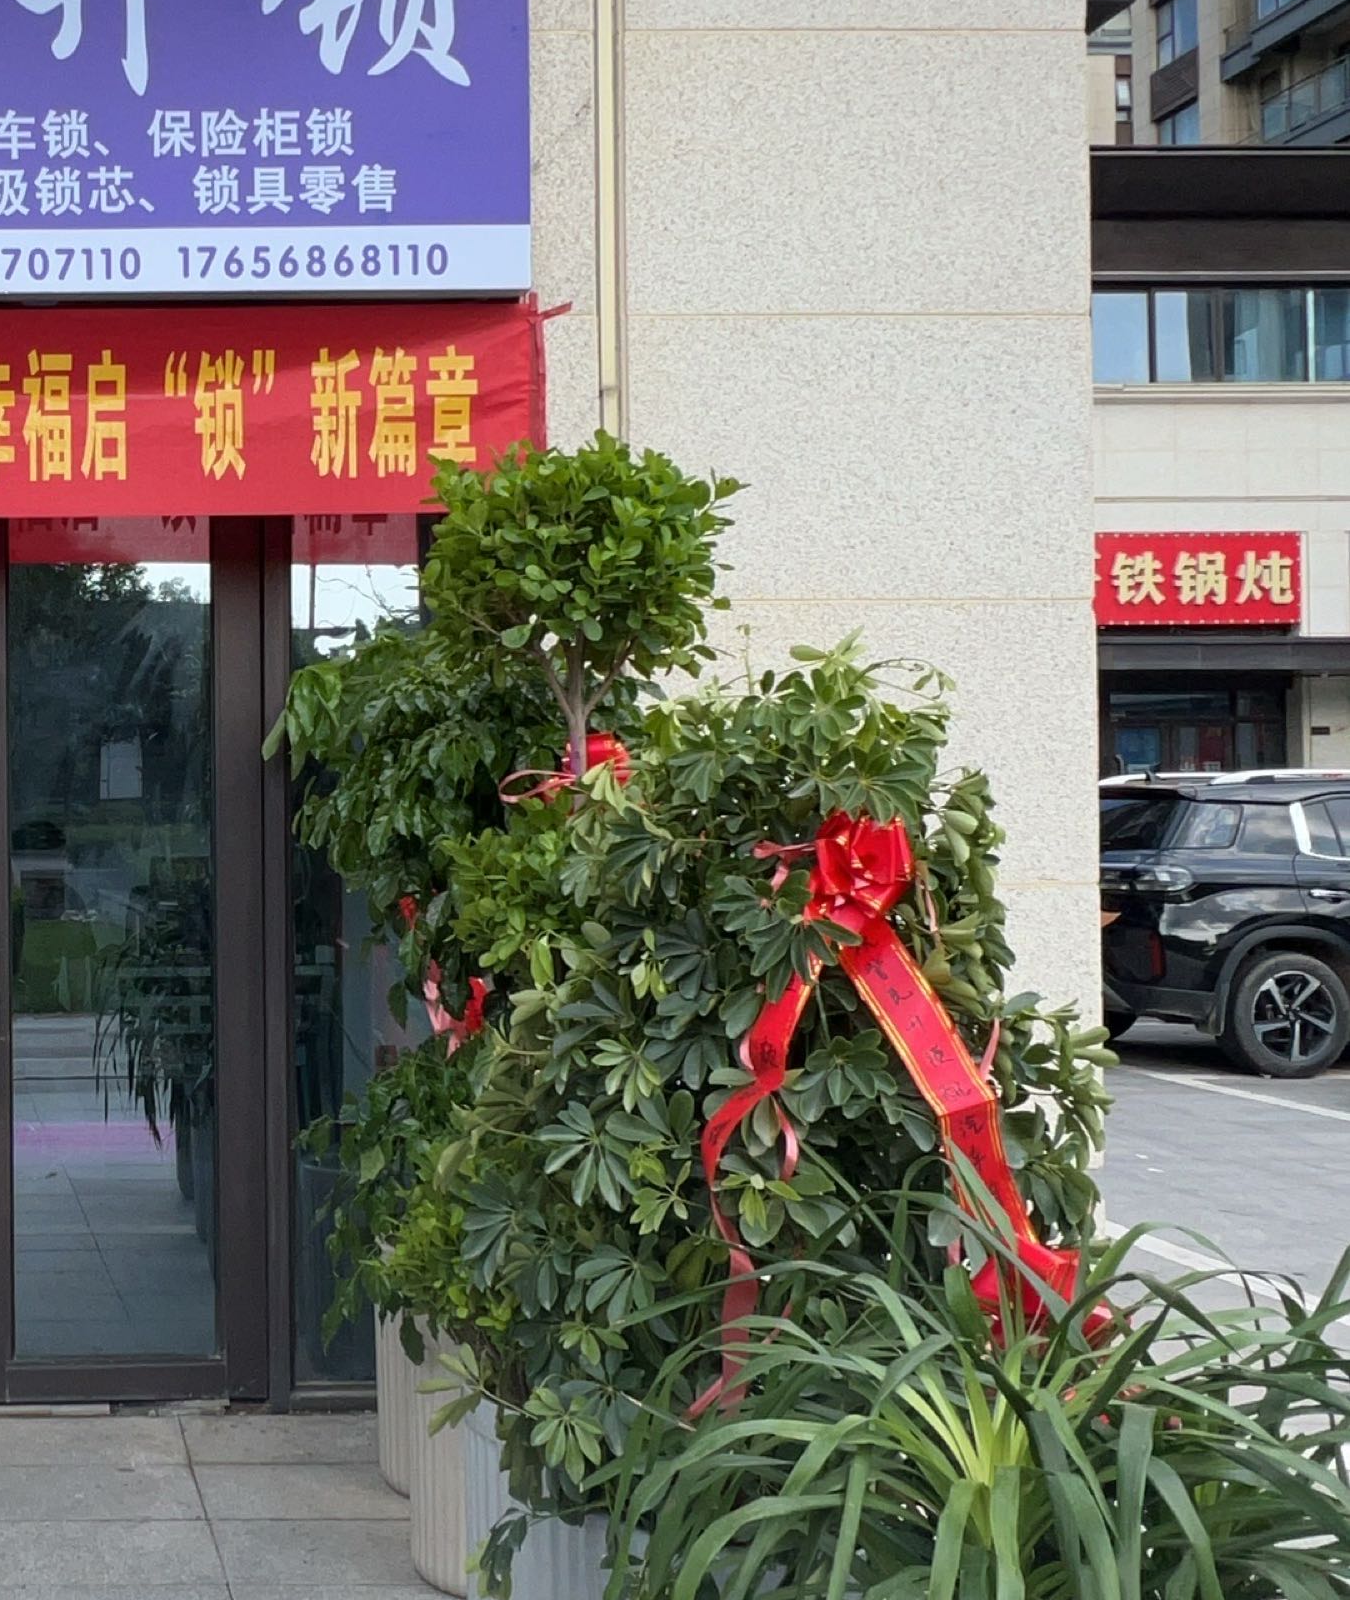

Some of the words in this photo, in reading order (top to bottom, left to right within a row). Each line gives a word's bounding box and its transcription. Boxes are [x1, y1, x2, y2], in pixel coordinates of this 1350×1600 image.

[177, 243, 449, 280] 17656868110
[1095, 550, 1295, 605] 铁锅炖
